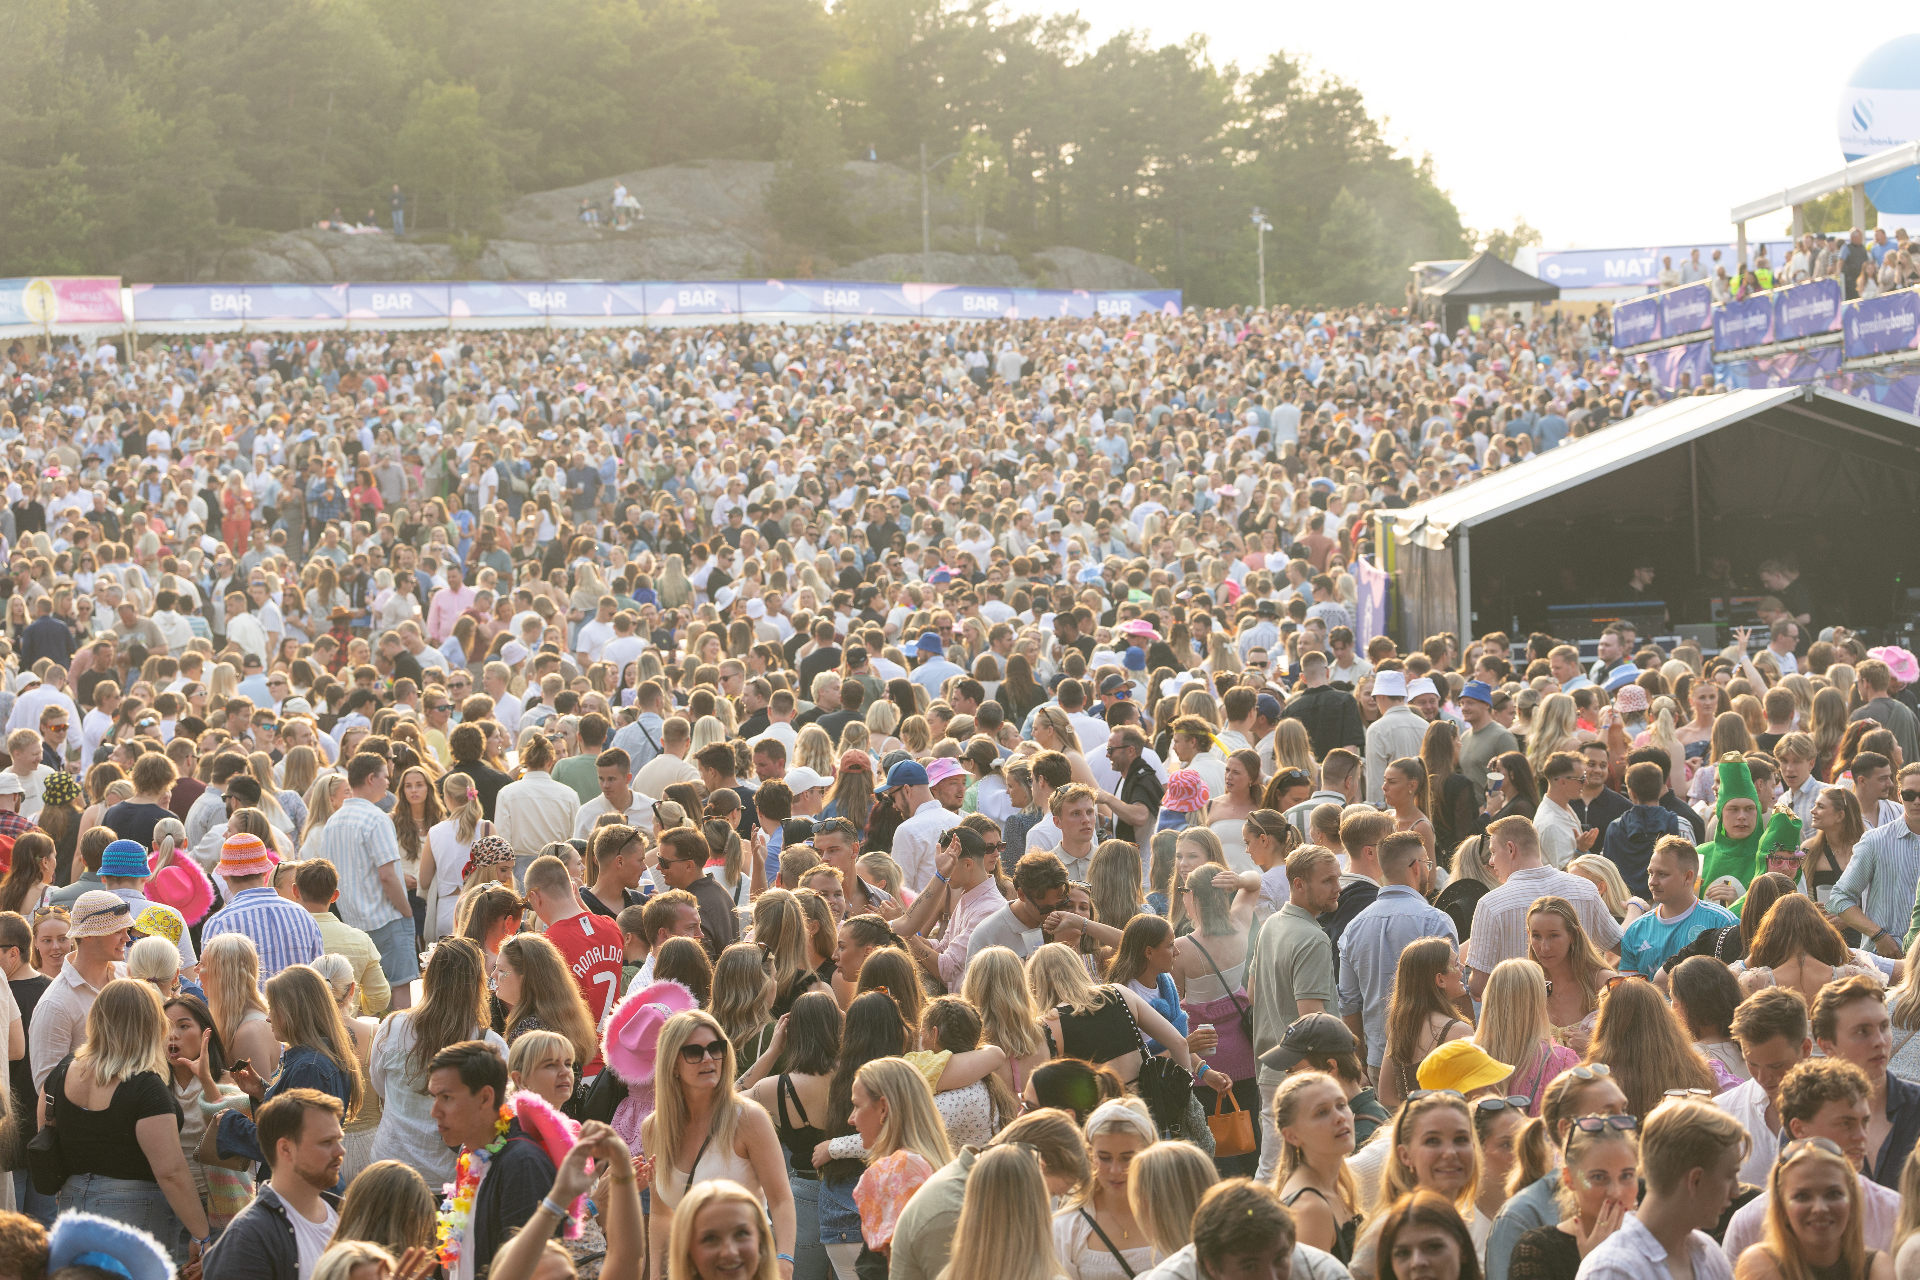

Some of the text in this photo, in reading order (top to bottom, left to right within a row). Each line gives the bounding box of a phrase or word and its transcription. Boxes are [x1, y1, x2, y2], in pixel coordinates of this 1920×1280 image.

[1604, 258, 1655, 278] MAT
[210, 293, 252, 312] BAR
[372, 293, 413, 311] BAR
[528, 291, 568, 309] BAR
[678, 290, 717, 308] BAR
[823, 290, 860, 306] BAR
[962, 295, 999, 312] BAR
[1097, 299, 1132, 316] BAR
[572, 944, 623, 979] RONALDO
[592, 971, 617, 1033] 7
